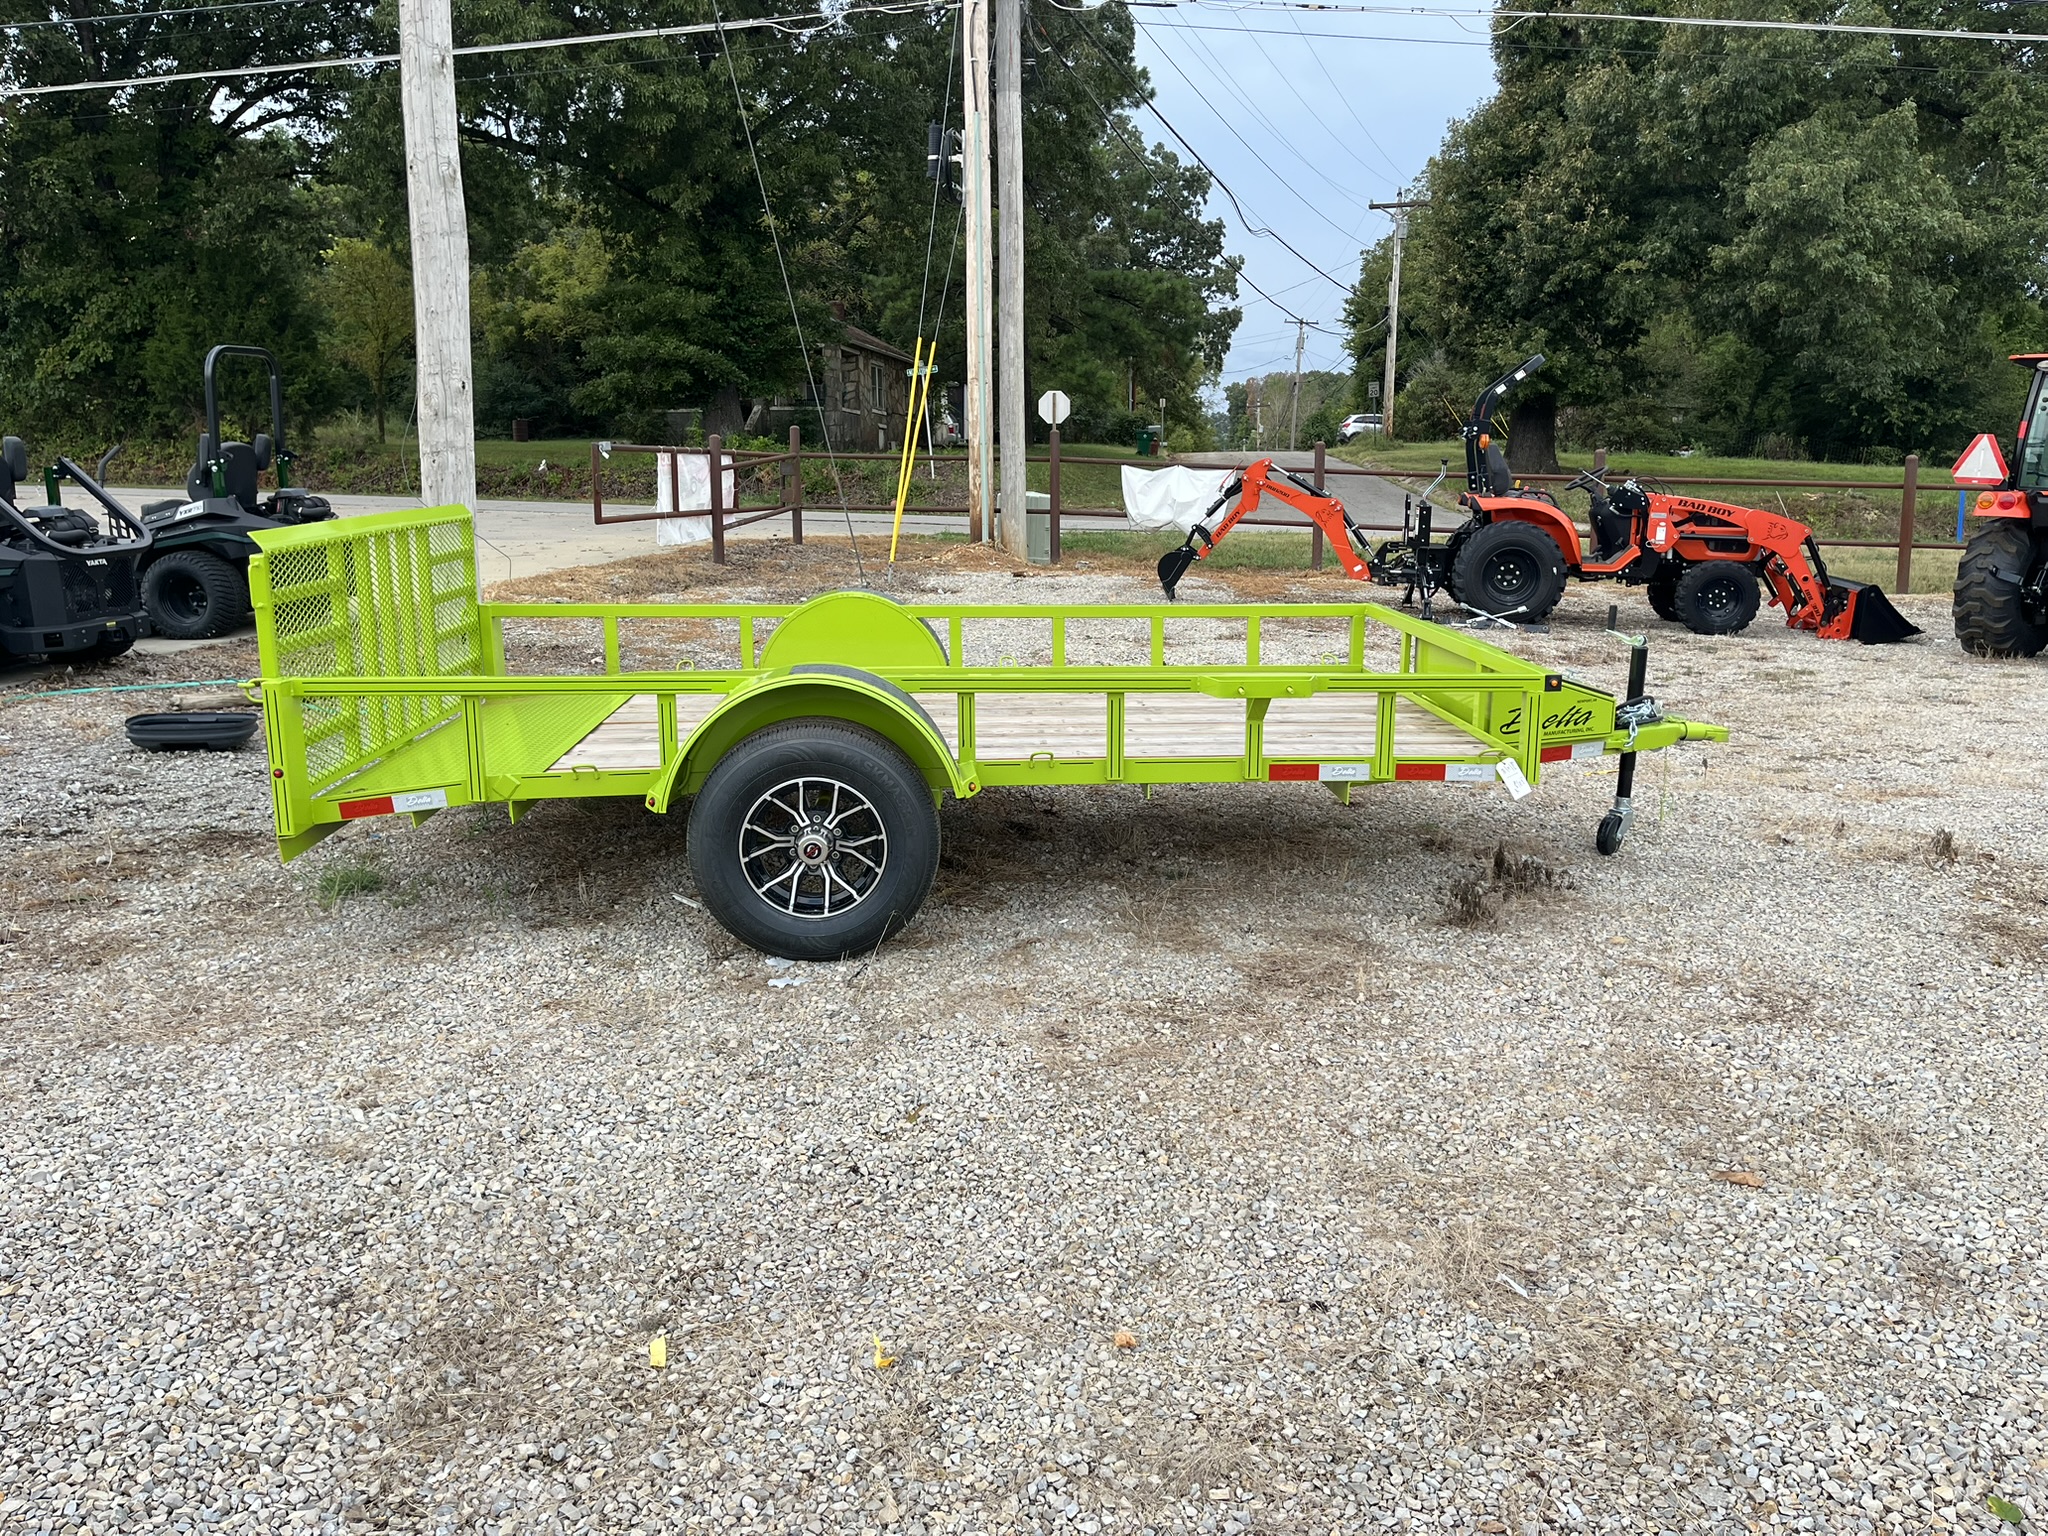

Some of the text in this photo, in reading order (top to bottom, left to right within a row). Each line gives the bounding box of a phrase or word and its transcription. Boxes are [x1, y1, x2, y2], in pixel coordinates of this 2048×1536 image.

[1678, 499, 1736, 517] BAD BOY
[85, 558, 108, 567] YAKTA
[1543, 727, 1585, 737] MANUFACTURING,
